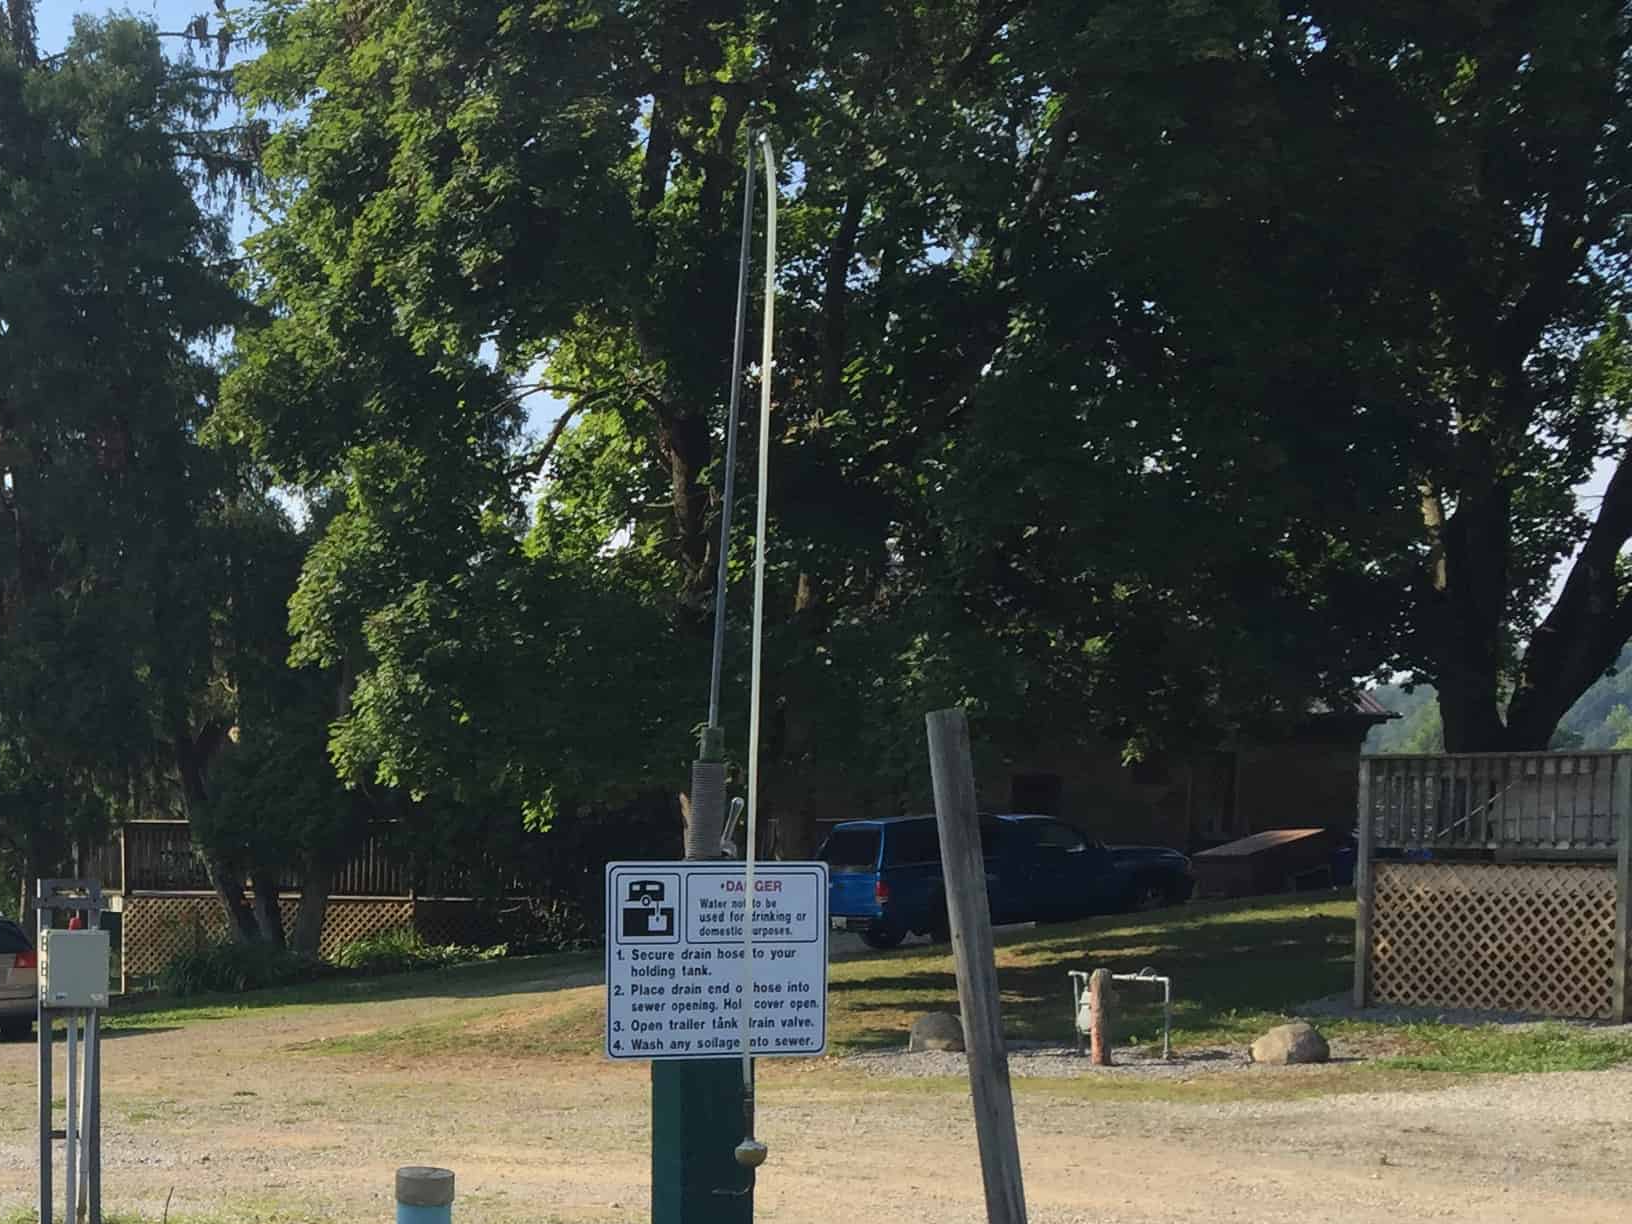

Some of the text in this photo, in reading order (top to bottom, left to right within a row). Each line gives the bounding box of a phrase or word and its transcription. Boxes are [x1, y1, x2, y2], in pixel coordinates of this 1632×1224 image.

[726, 880, 782, 892] DAGER
[699, 898, 727, 909] Water
[766, 898, 777, 909] be
[699, 911, 724, 923] used
[730, 911, 744, 922] for
[796, 912, 807, 922] or
[699, 926, 793, 938] domestic urposes.
[616, 948, 797, 961] 1. Secure drain hose to your
[631, 965, 712, 979] holding tank.
[614, 985, 625, 997] 2.
[631, 984, 665, 996] Place
[671, 983, 702, 995] drain
[708, 982, 730, 994] end
[753, 981, 782, 993] hose
[787, 981, 810, 993] into
[631, 998, 820, 1014] sewer opening. Hol cover open.
[613, 1020, 625, 1032] 3.
[631, 1019, 663, 1033] Open
[669, 1018, 706, 1030] trailer
[712, 1017, 738, 1029] tank
[780, 1016, 814, 1028] valve.
[613, 1036, 814, 1052] 4. Wash any soilage nto sewer.
